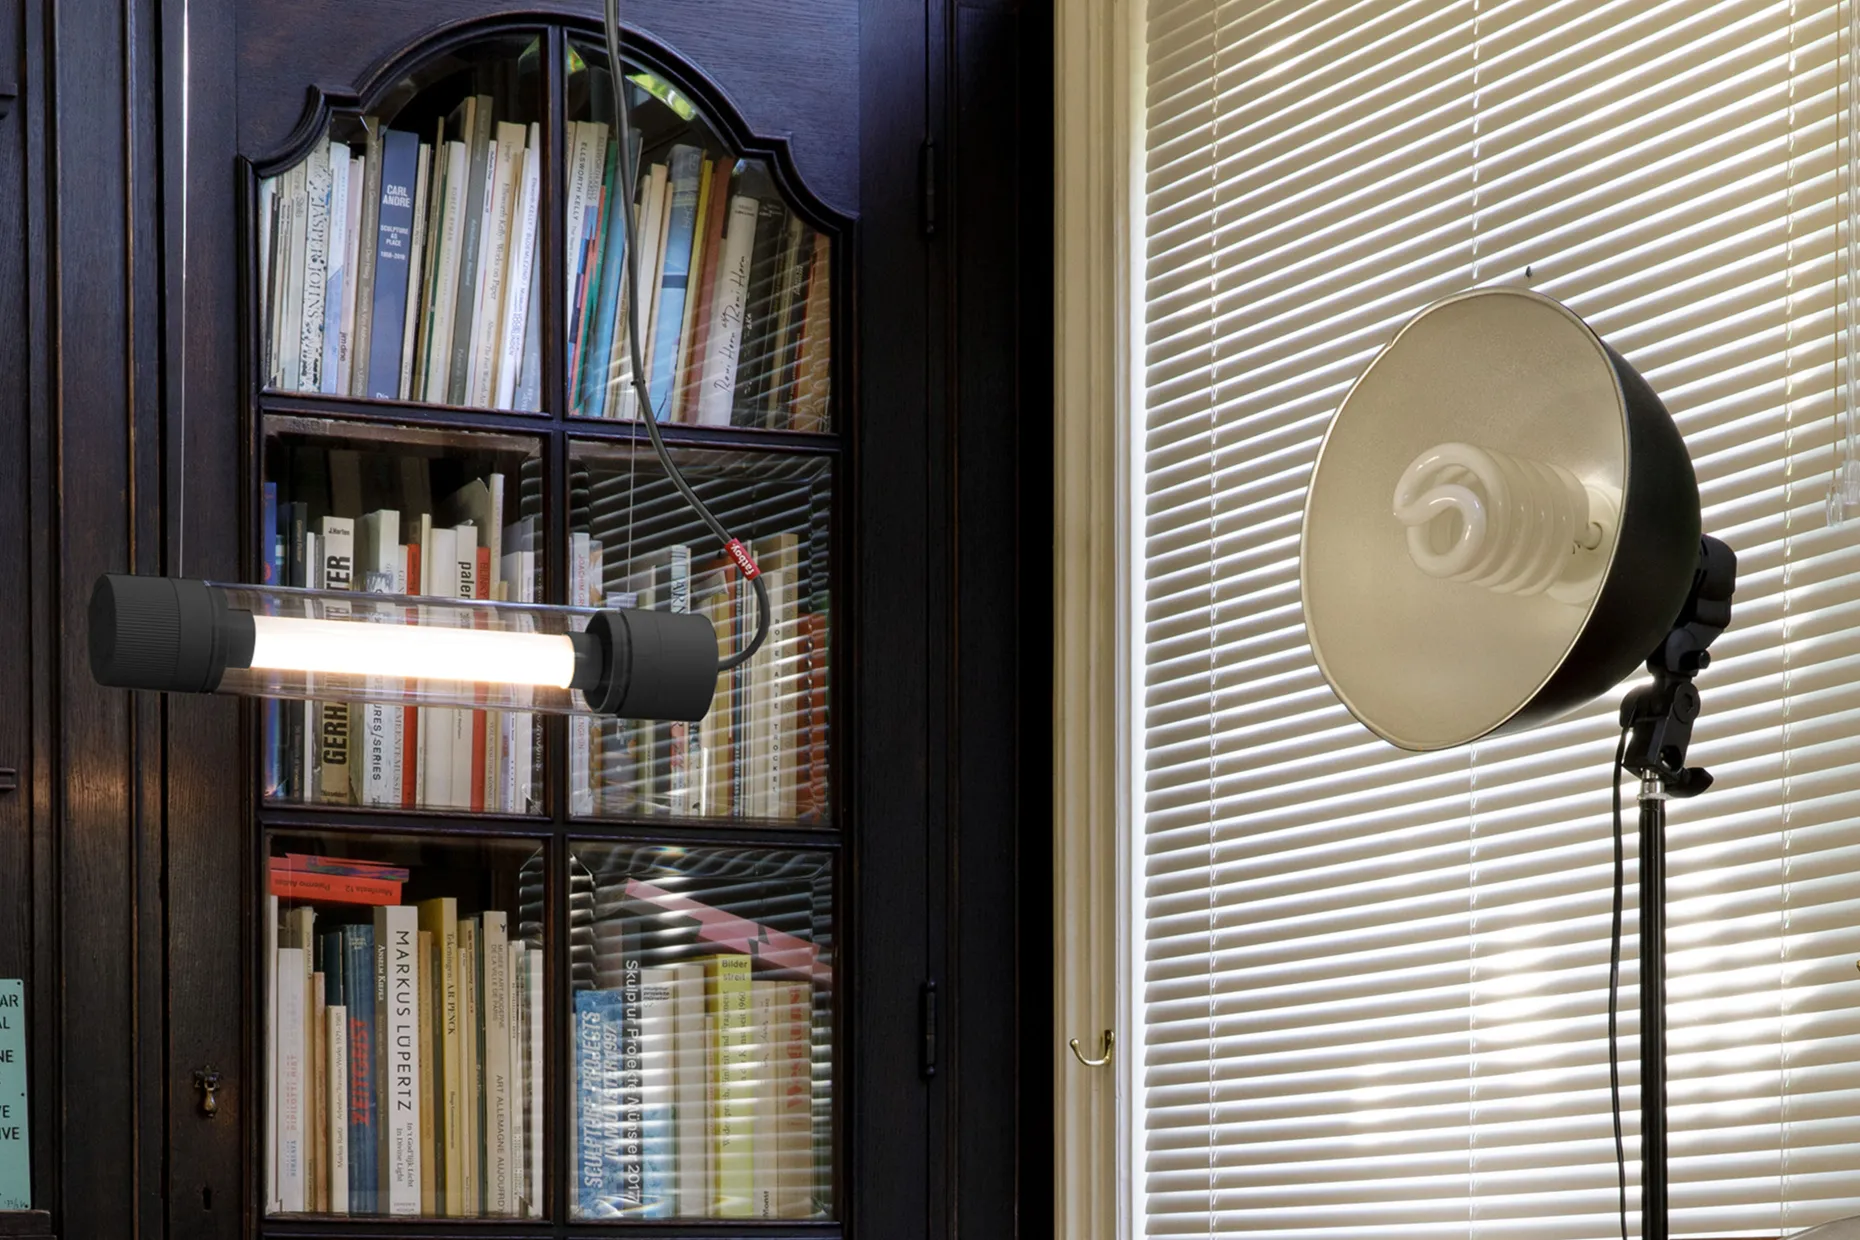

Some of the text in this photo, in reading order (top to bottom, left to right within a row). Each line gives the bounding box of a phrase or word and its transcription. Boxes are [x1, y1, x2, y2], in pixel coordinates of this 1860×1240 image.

[576, 142, 587, 192] ELLSWORTH
[382, 195, 411, 208] ANDRE
[387, 185, 408, 196] CARL
[527, 205, 535, 225] KELLY
[572, 195, 581, 220] KELLY
[310, 202, 326, 259] JASPER
[381, 225, 408, 235] SCULPTURE
[386, 238, 401, 247] PLACE
[494, 244, 504, 266] Works
[493, 268, 499, 277] on
[733, 255, 747, 288] Horn
[307, 266, 326, 318] JOHNS
[490, 279, 500, 299] Paper
[724, 290, 741, 322] Roni
[721, 332, 736, 361] Horn
[713, 364, 732, 391] Roni
[326, 555, 351, 590] TER
[458, 562, 474, 598] paler
[480, 562, 488, 598] BLINKY
[577, 554, 585, 591] JOACHIM
[299, 881, 330, 892] Palermo
[356, 886, 393, 896] Manifesta
[445, 933, 454, 981] Tekeningen:
[491, 944, 497, 952] DE
[721, 959, 748, 969] Bilder
[492, 988, 498, 999] DE
[396, 930, 411, 1111] MARKUS LÜPERTZ
[448, 1002, 456, 1035] PENCK
[603, 1024, 617, 1057] 1997
[350, 1017, 370, 1127] ZEITGEIST
[625, 960, 641, 1203] Skulptur Projekte Münster 2017
[582, 1011, 603, 1187] SCULPTURE PROJECTS
[406, 1122, 413, 1130] In
[496, 1075, 505, 1155] ART ALLEMAGNE
[396, 1128, 403, 1136] In
[605, 1141, 618, 1159] IN
[395, 1165, 404, 1182] Light
